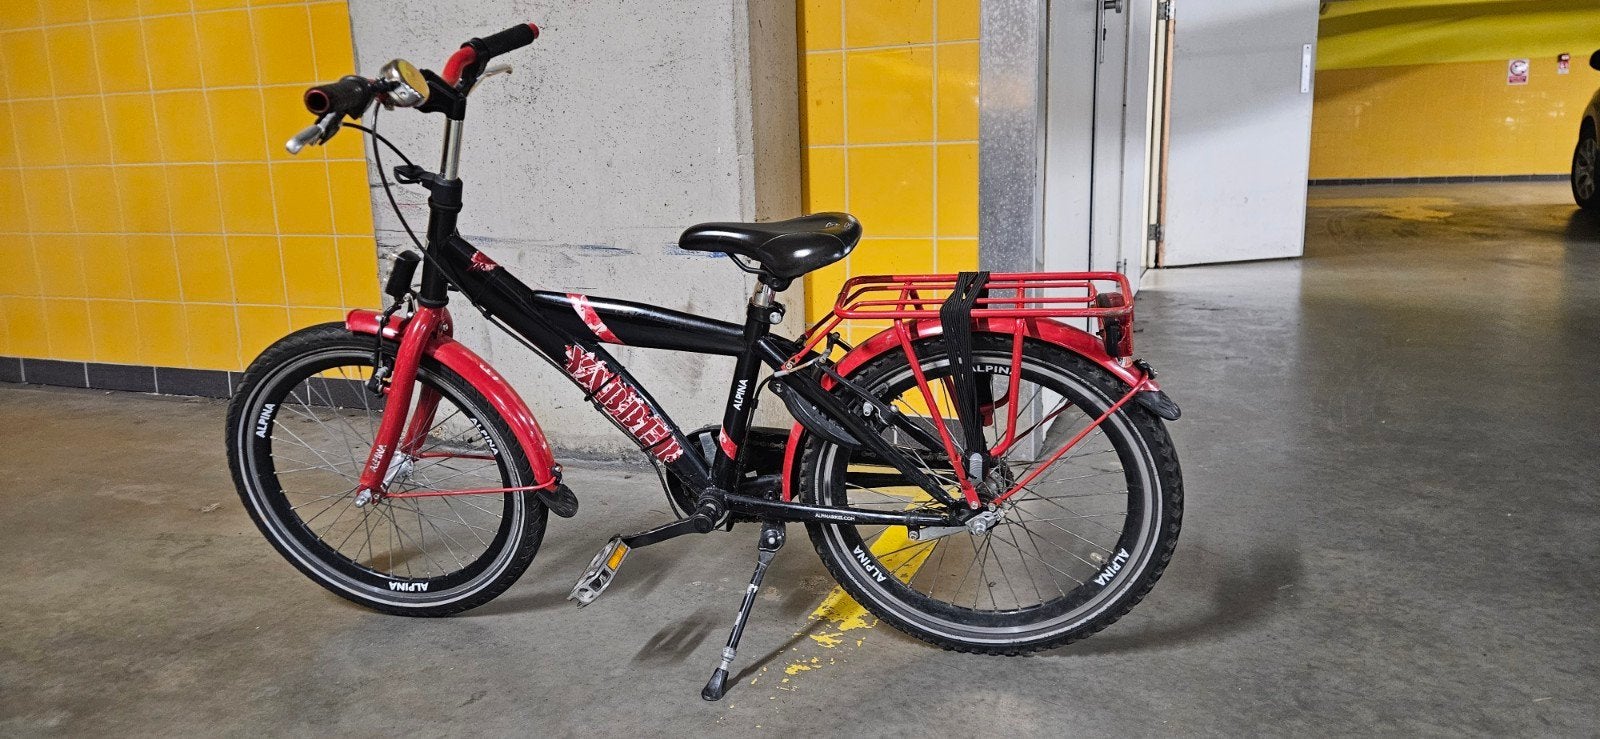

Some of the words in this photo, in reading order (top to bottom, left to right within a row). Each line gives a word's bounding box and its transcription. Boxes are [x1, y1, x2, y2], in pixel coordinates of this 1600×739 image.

[565, 343, 683, 463] YABBER
[732, 379, 749, 411] ALPINA
[255, 403, 276, 439] ALPINA
[469, 417, 500, 456] ALPINA
[853, 544, 887, 583] ALPINA
[1092, 547, 1130, 586] ALPINA
[388, 581, 429, 592] ALPINA
